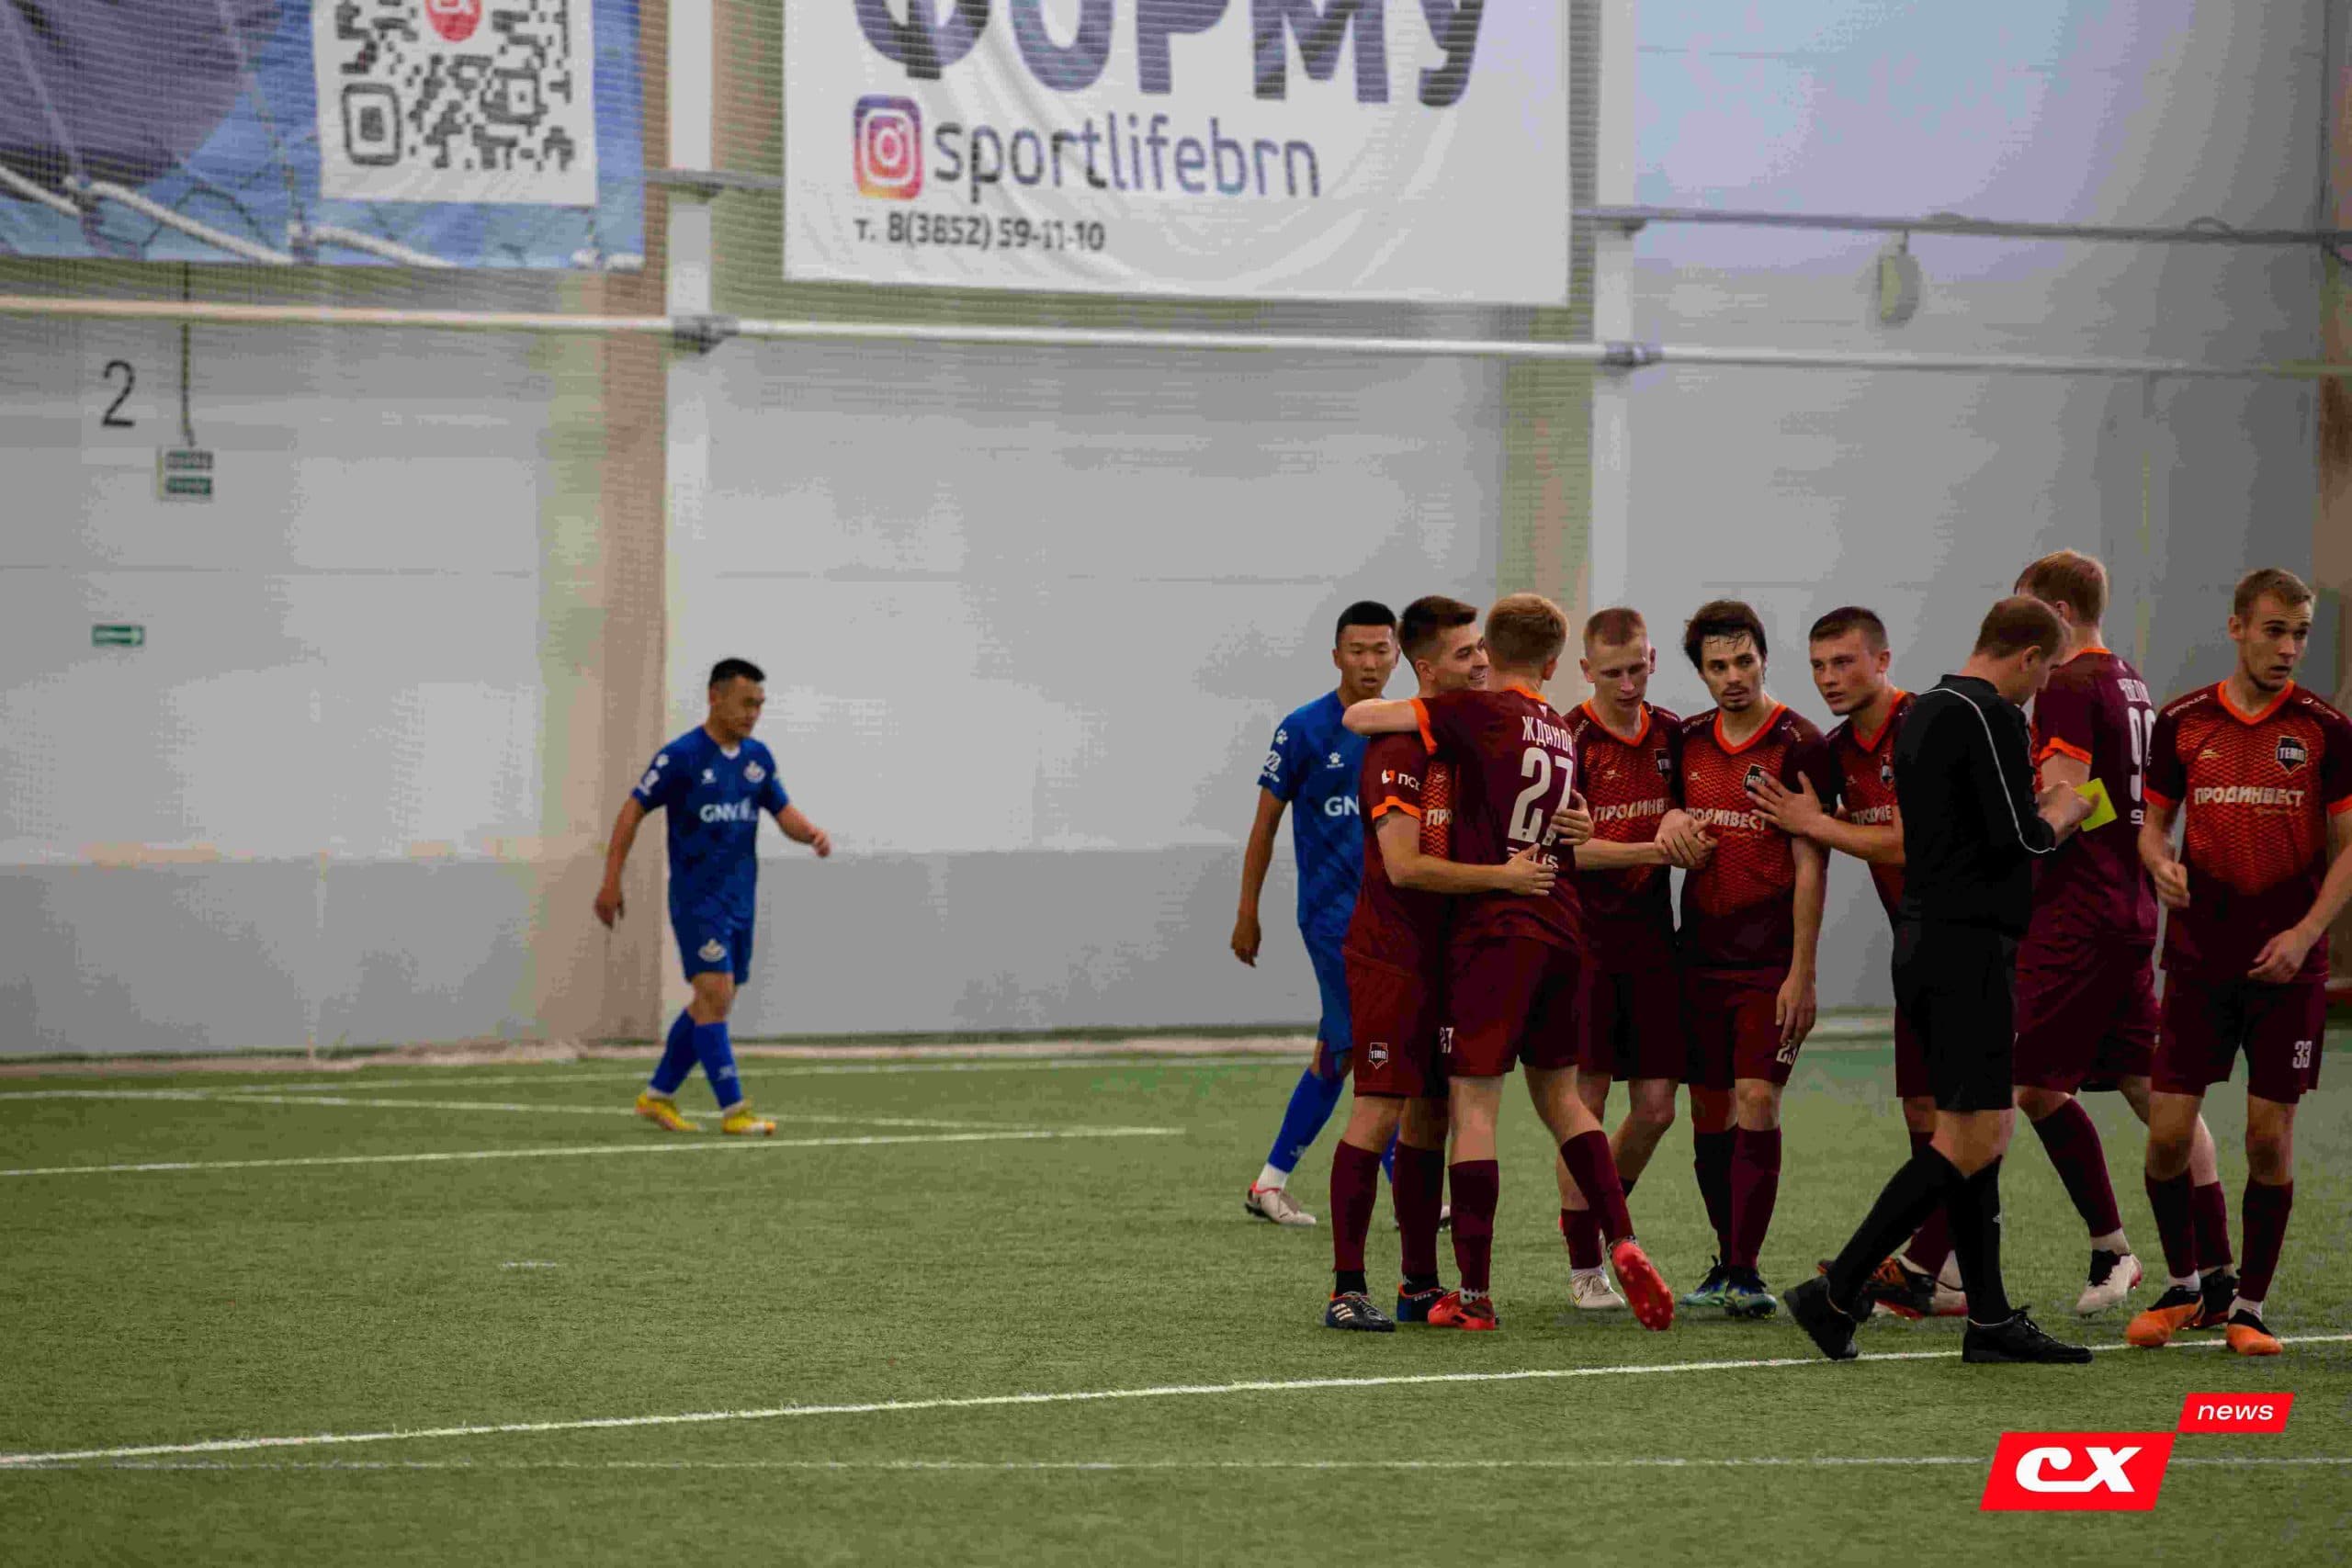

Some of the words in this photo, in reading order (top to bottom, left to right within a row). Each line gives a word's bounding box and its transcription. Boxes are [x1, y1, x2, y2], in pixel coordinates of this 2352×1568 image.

[933, 110, 1320, 204] sportlifebrn
[888, 211, 991, 251] 8(3852)
[997, 217, 1105, 252] 59-11-10
[102, 360, 135, 428] 2
[1508, 746, 1573, 846] 27
[2194, 785, 2305, 807] ПРОДИНВЕСТ
[2292, 1040, 2312, 1069] 33
